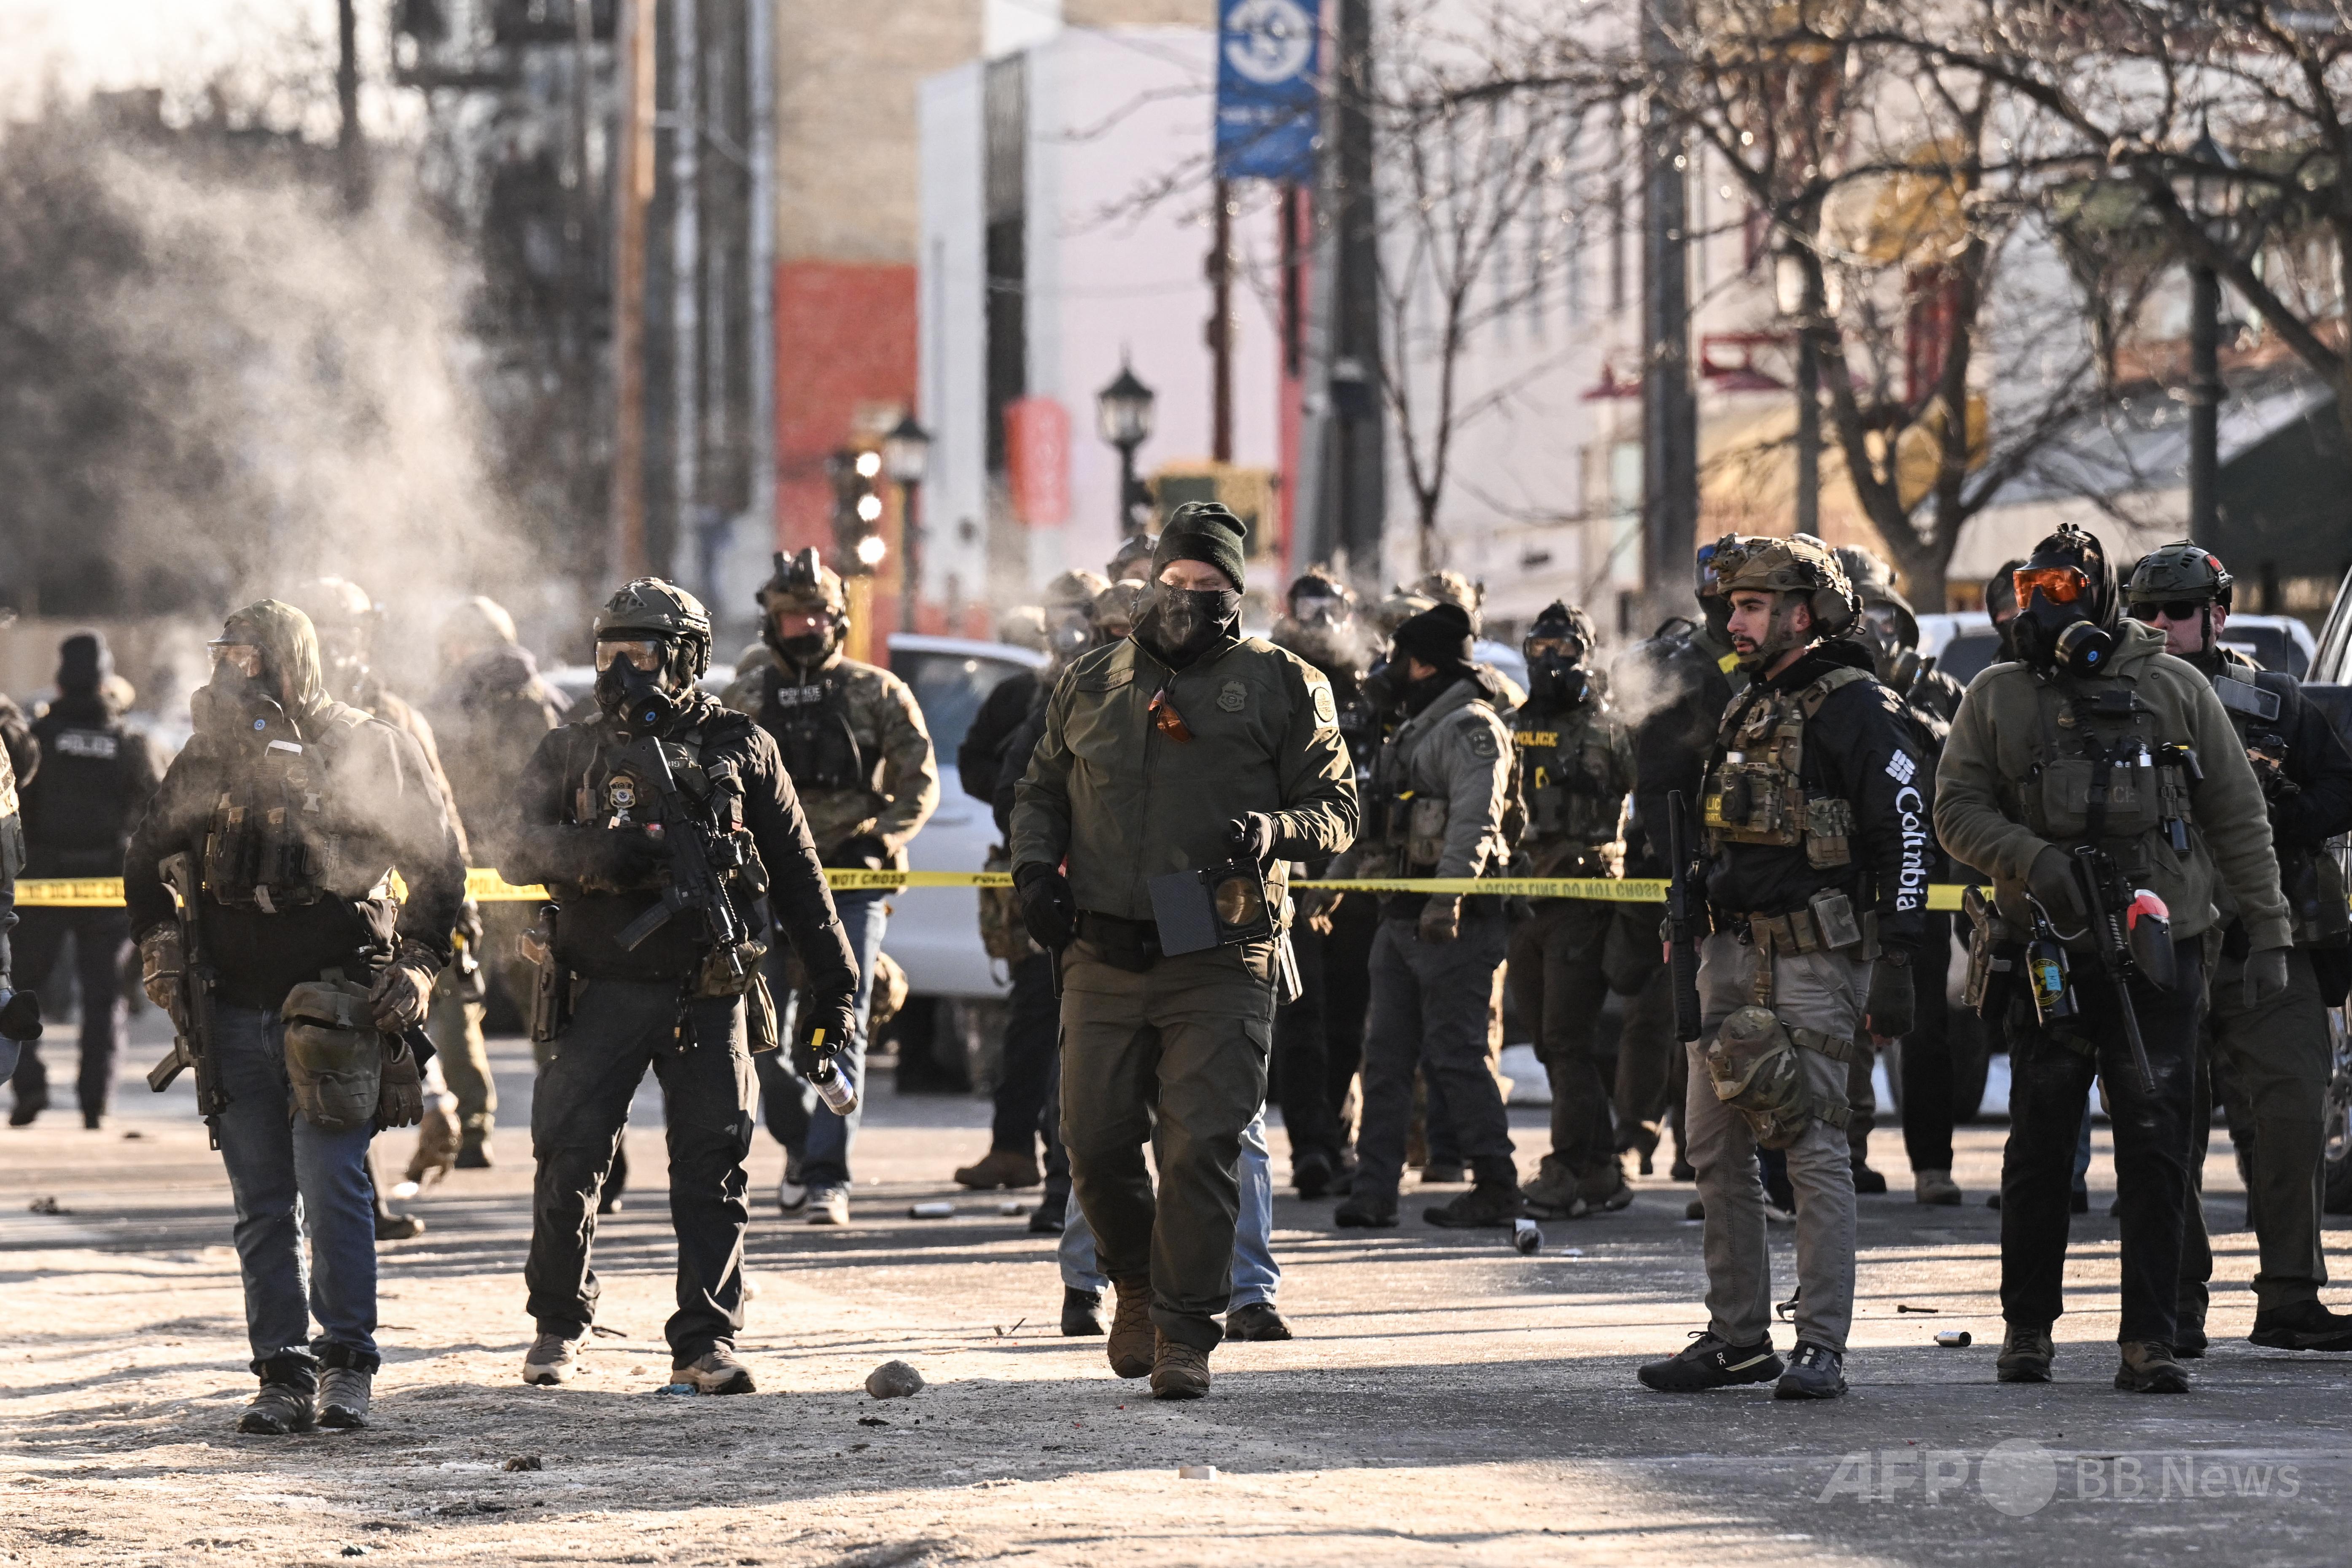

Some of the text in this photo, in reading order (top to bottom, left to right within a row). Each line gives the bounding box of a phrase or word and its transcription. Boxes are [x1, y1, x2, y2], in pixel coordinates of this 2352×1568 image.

[832, 873, 907, 885] NOT CROSS
[1896, 787, 1927, 911] Columbia
